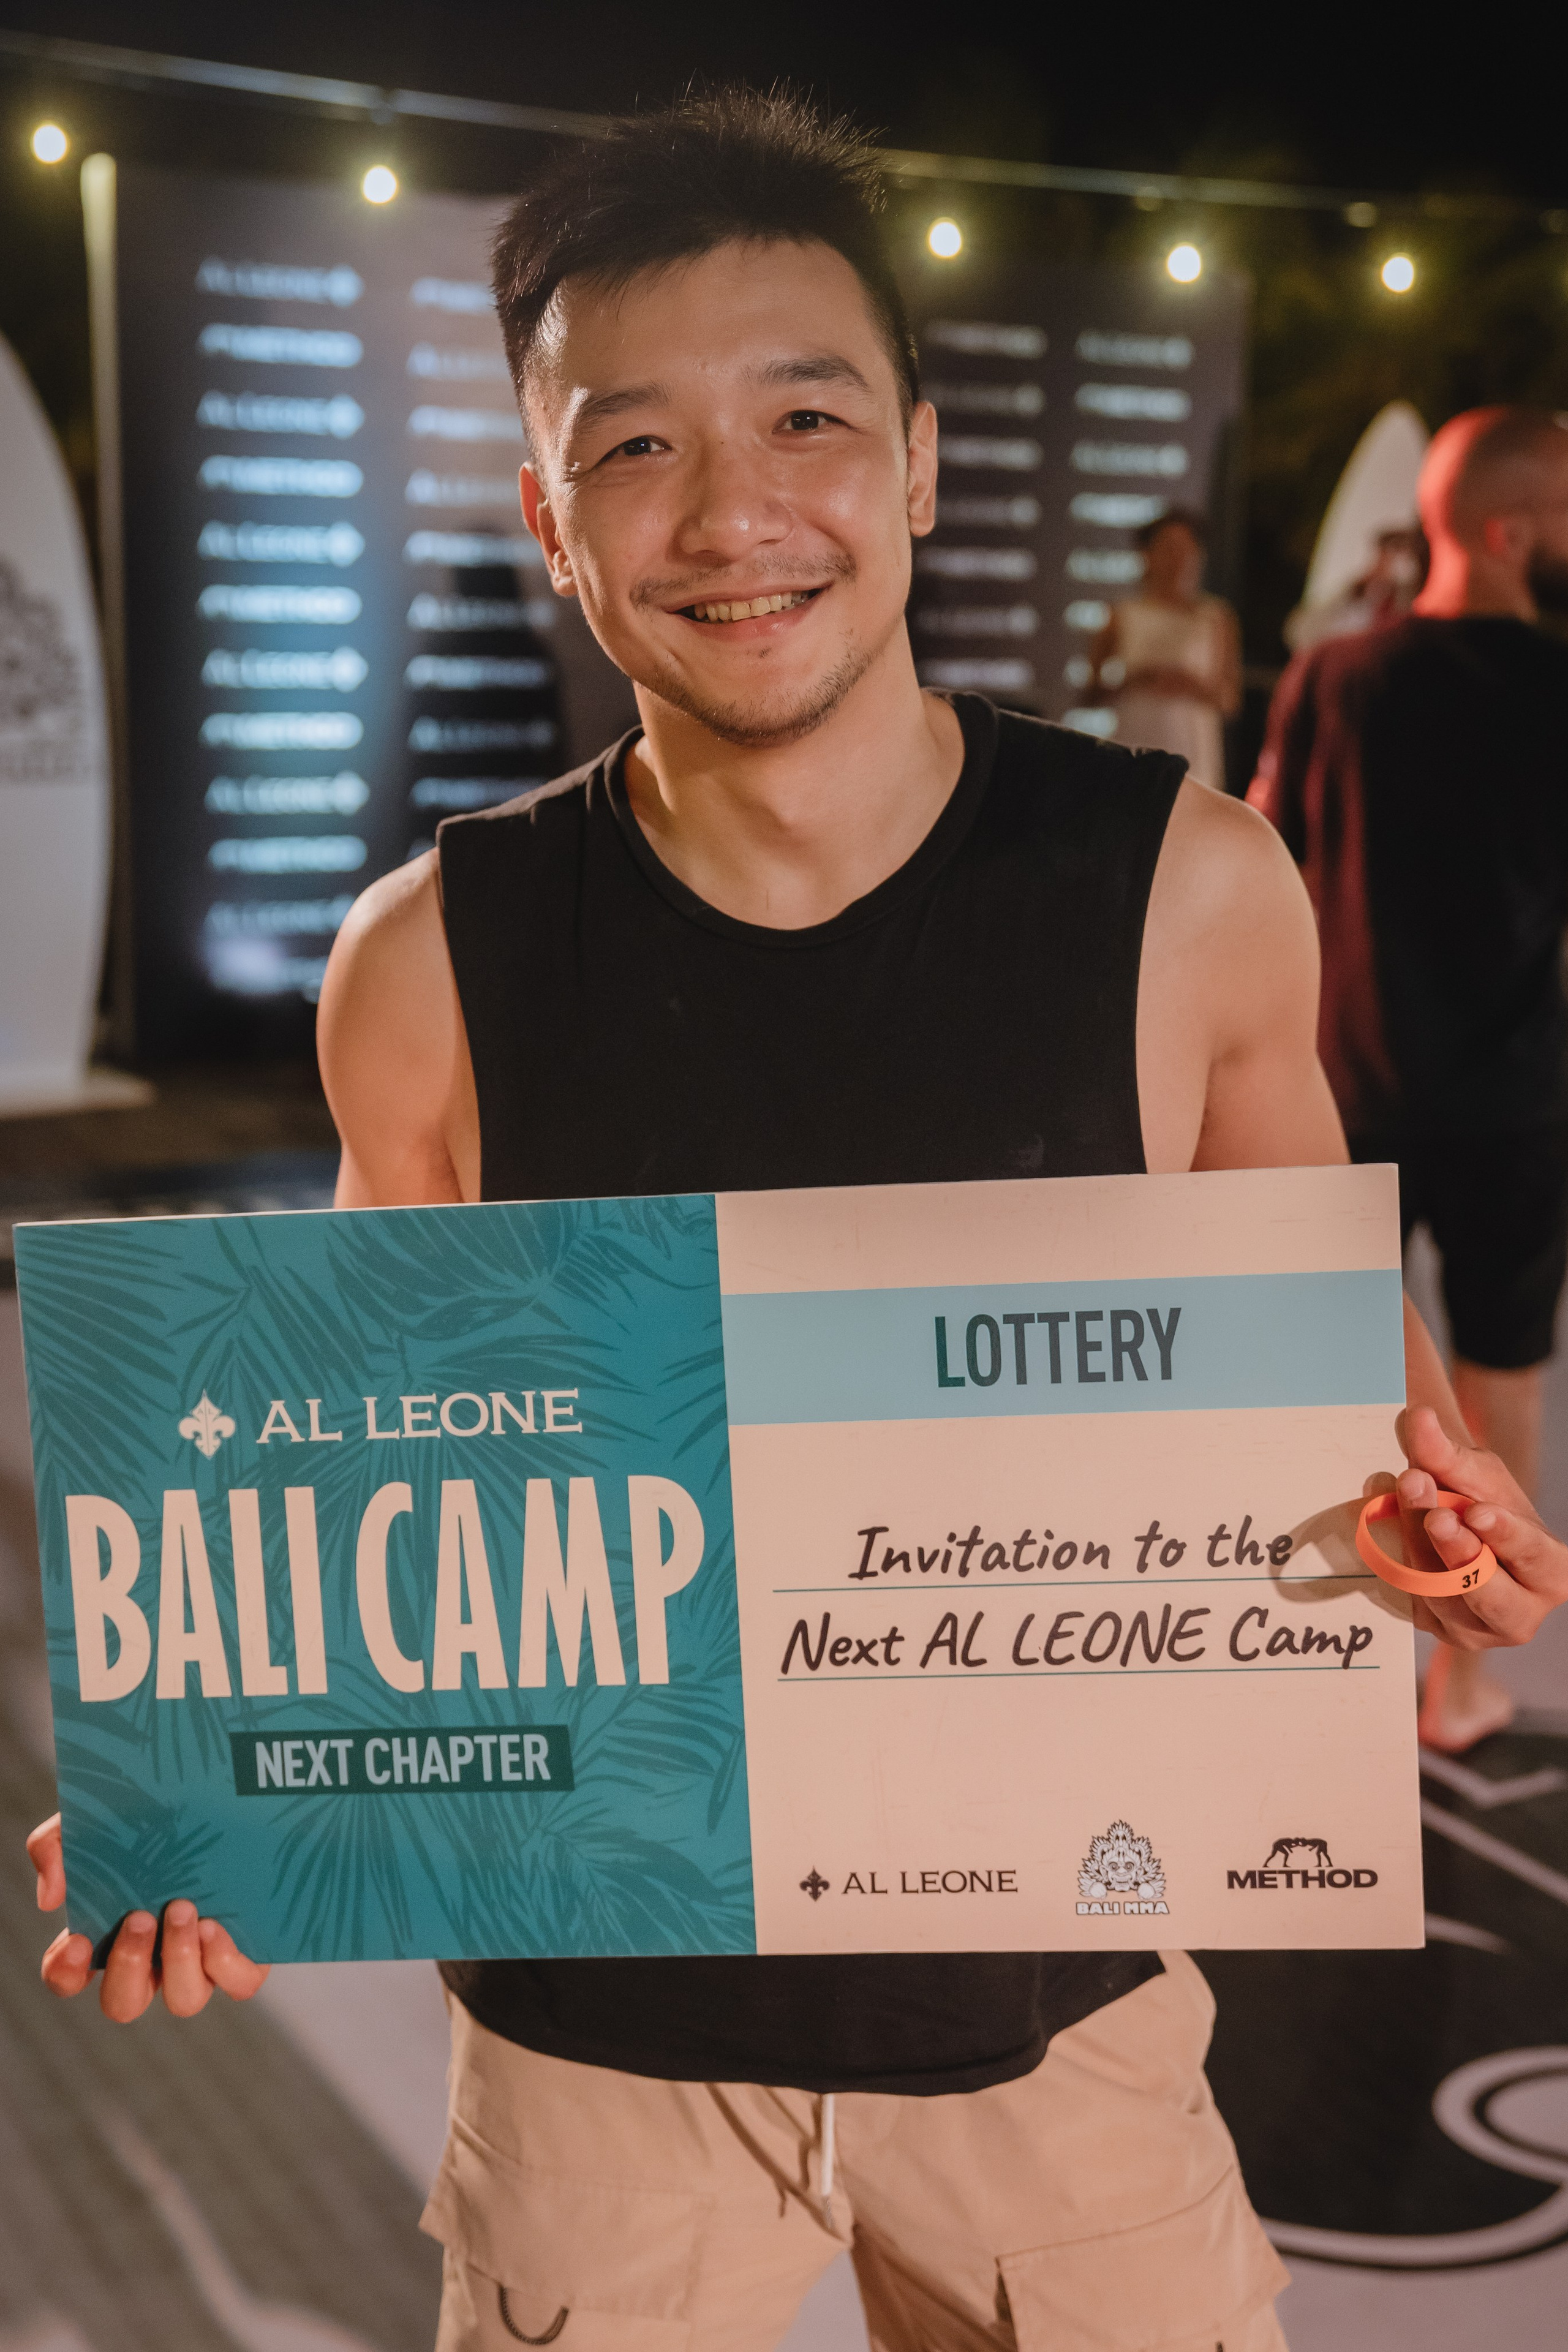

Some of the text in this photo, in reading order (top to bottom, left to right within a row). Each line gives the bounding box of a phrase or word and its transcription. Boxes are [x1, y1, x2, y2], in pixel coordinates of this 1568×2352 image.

[935, 1307, 1182, 1388] LOTTERY
[256, 1387, 583, 1444] AL LEONE
[848, 1515, 1293, 1580] Invitation to the
[65, 1475, 705, 1702] BALI CAMP
[1461, 1569, 1480, 1589] 37
[781, 1604, 1374, 1675] Next AL LEONE Camp
[255, 1733, 551, 1789] NEXT CHAPTER
[842, 1869, 1018, 1894] AL LEONE
[1227, 1868, 1379, 1890] METHOD
[1076, 1901, 1170, 1915] BALI MMA
